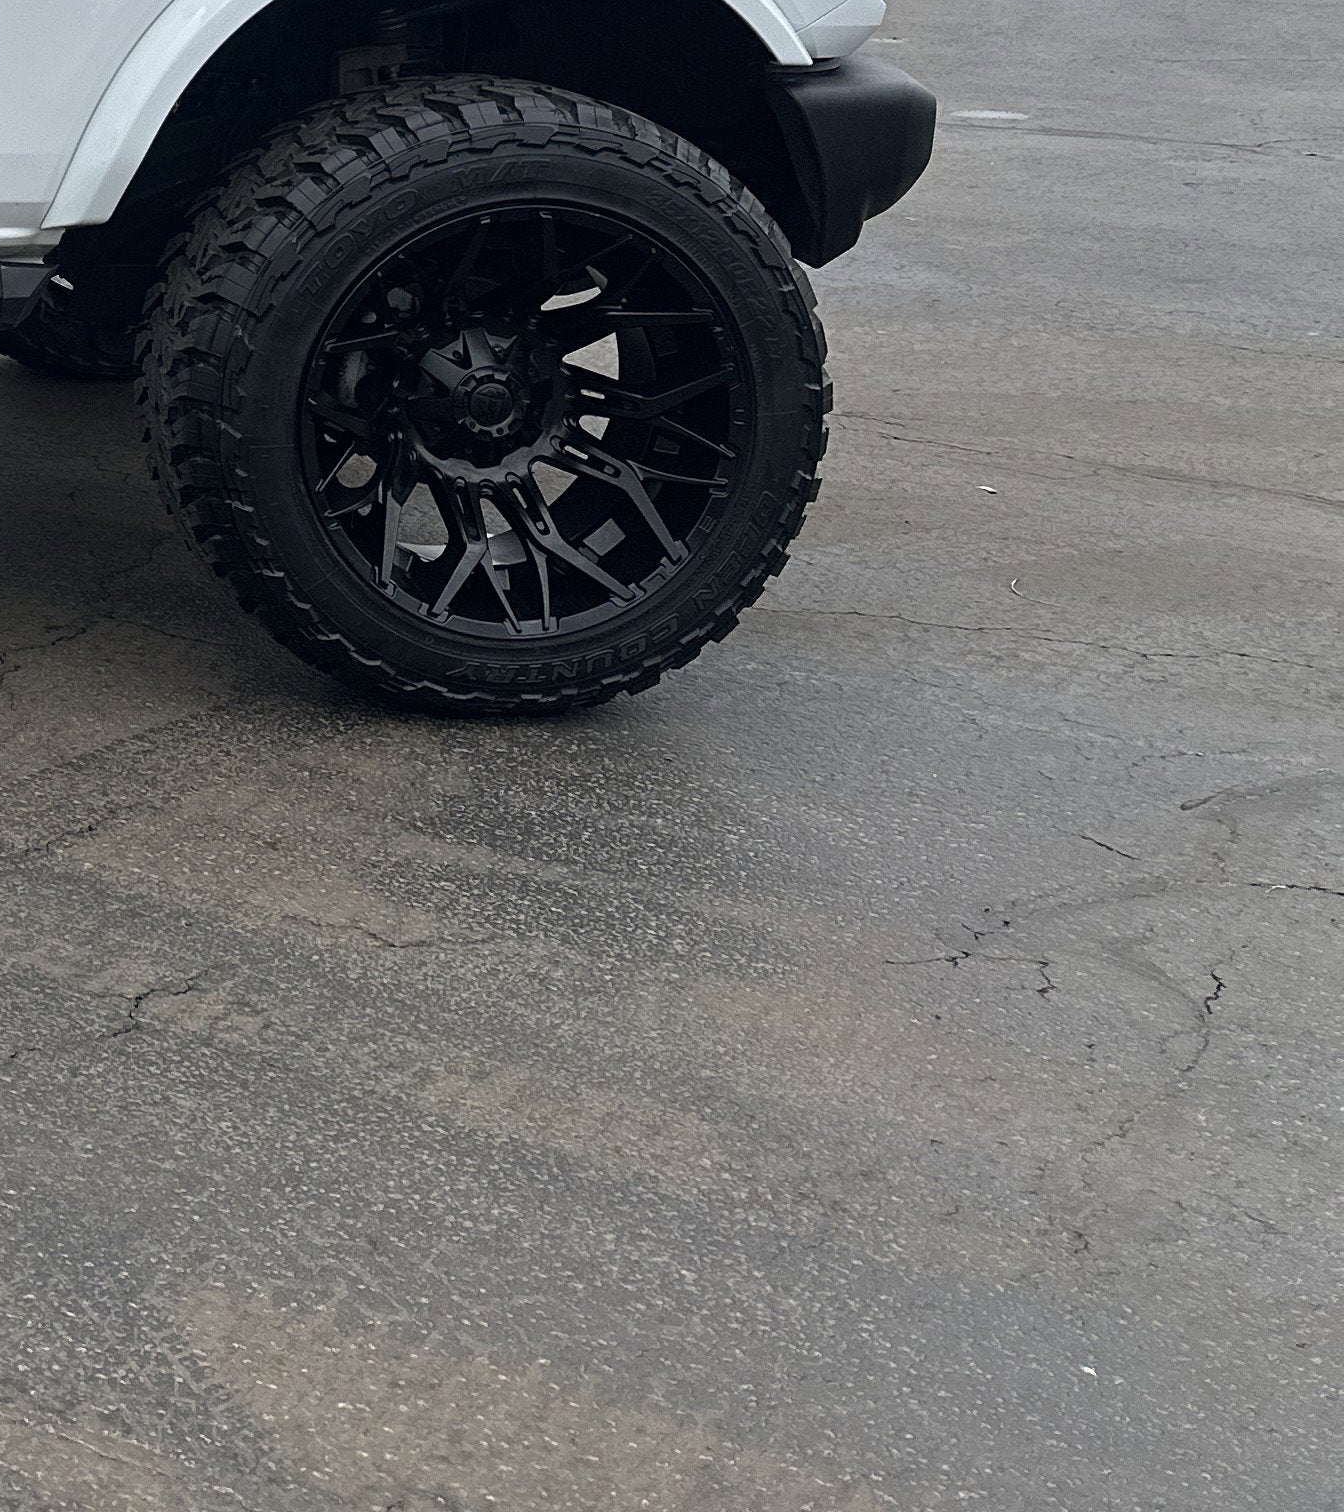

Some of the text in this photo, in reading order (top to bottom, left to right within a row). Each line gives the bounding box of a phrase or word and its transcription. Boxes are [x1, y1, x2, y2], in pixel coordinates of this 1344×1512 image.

[297, 188, 418, 295] TOYO
[452, 158, 551, 188] M/T
[445, 612, 680, 684] COUNTRY
